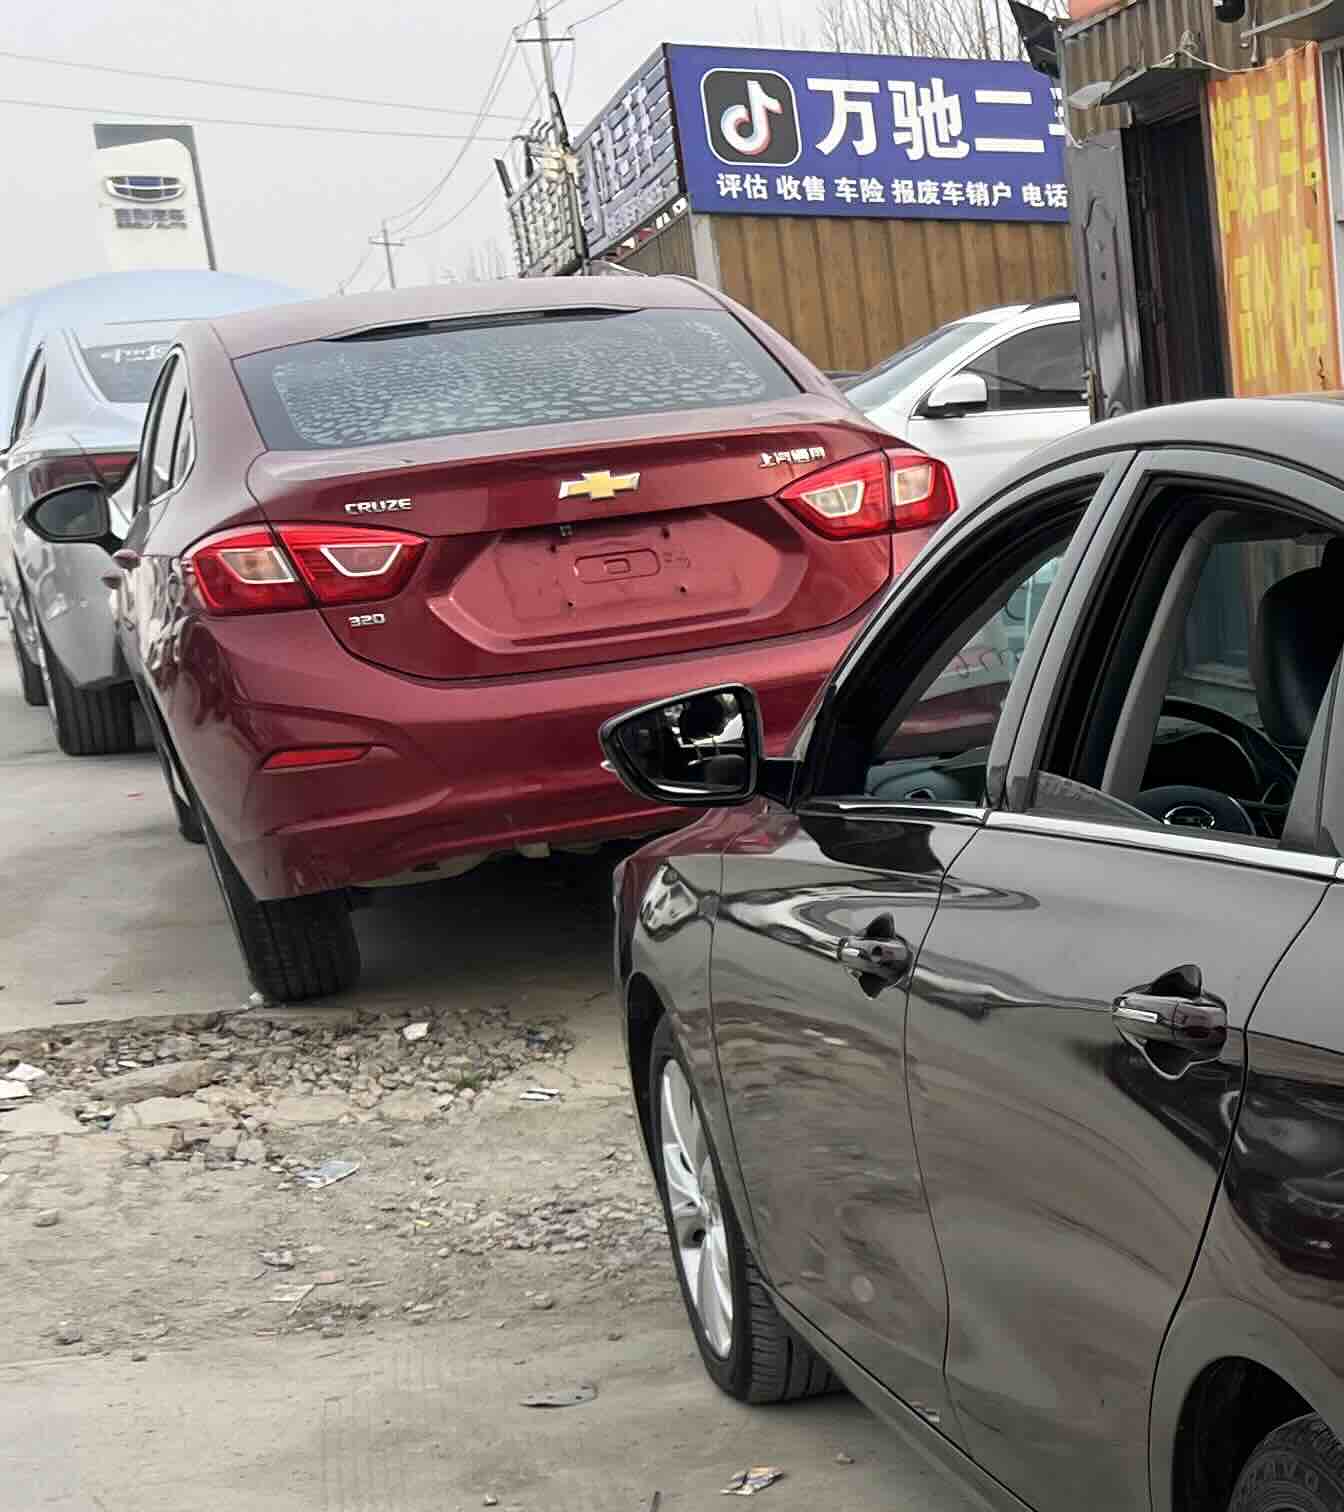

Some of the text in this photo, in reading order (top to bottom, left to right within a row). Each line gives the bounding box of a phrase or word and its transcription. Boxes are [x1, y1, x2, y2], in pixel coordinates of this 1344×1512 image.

[807, 77, 1066, 161] 万驰二
[716, 172, 1069, 210] 评估 收售 车险 报废车销户 电话
[344, 497, 413, 516] CRUZE
[348, 612, 386, 628] 320
